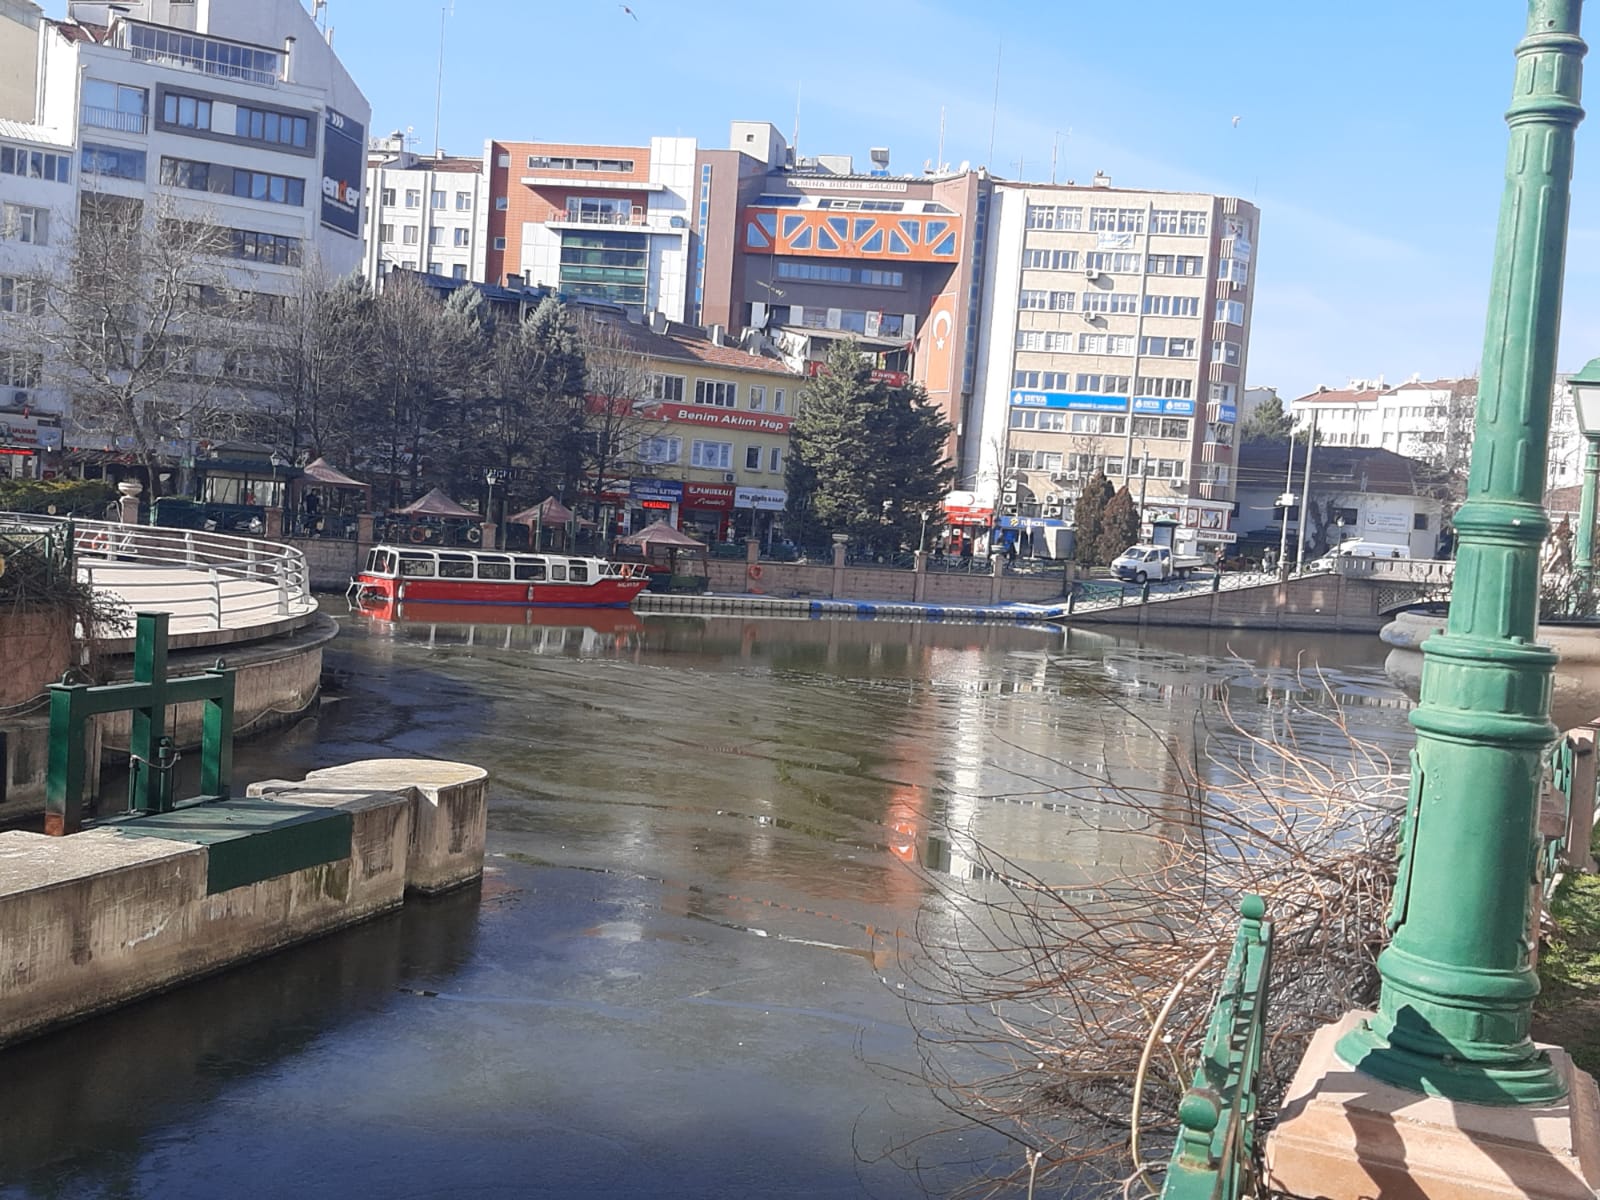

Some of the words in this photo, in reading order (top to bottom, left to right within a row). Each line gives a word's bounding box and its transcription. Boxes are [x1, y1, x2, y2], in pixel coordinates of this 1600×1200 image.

[678, 409, 718, 423] Benim
[721, 414, 756, 427] Aklım
[760, 419, 784, 431] Hep
